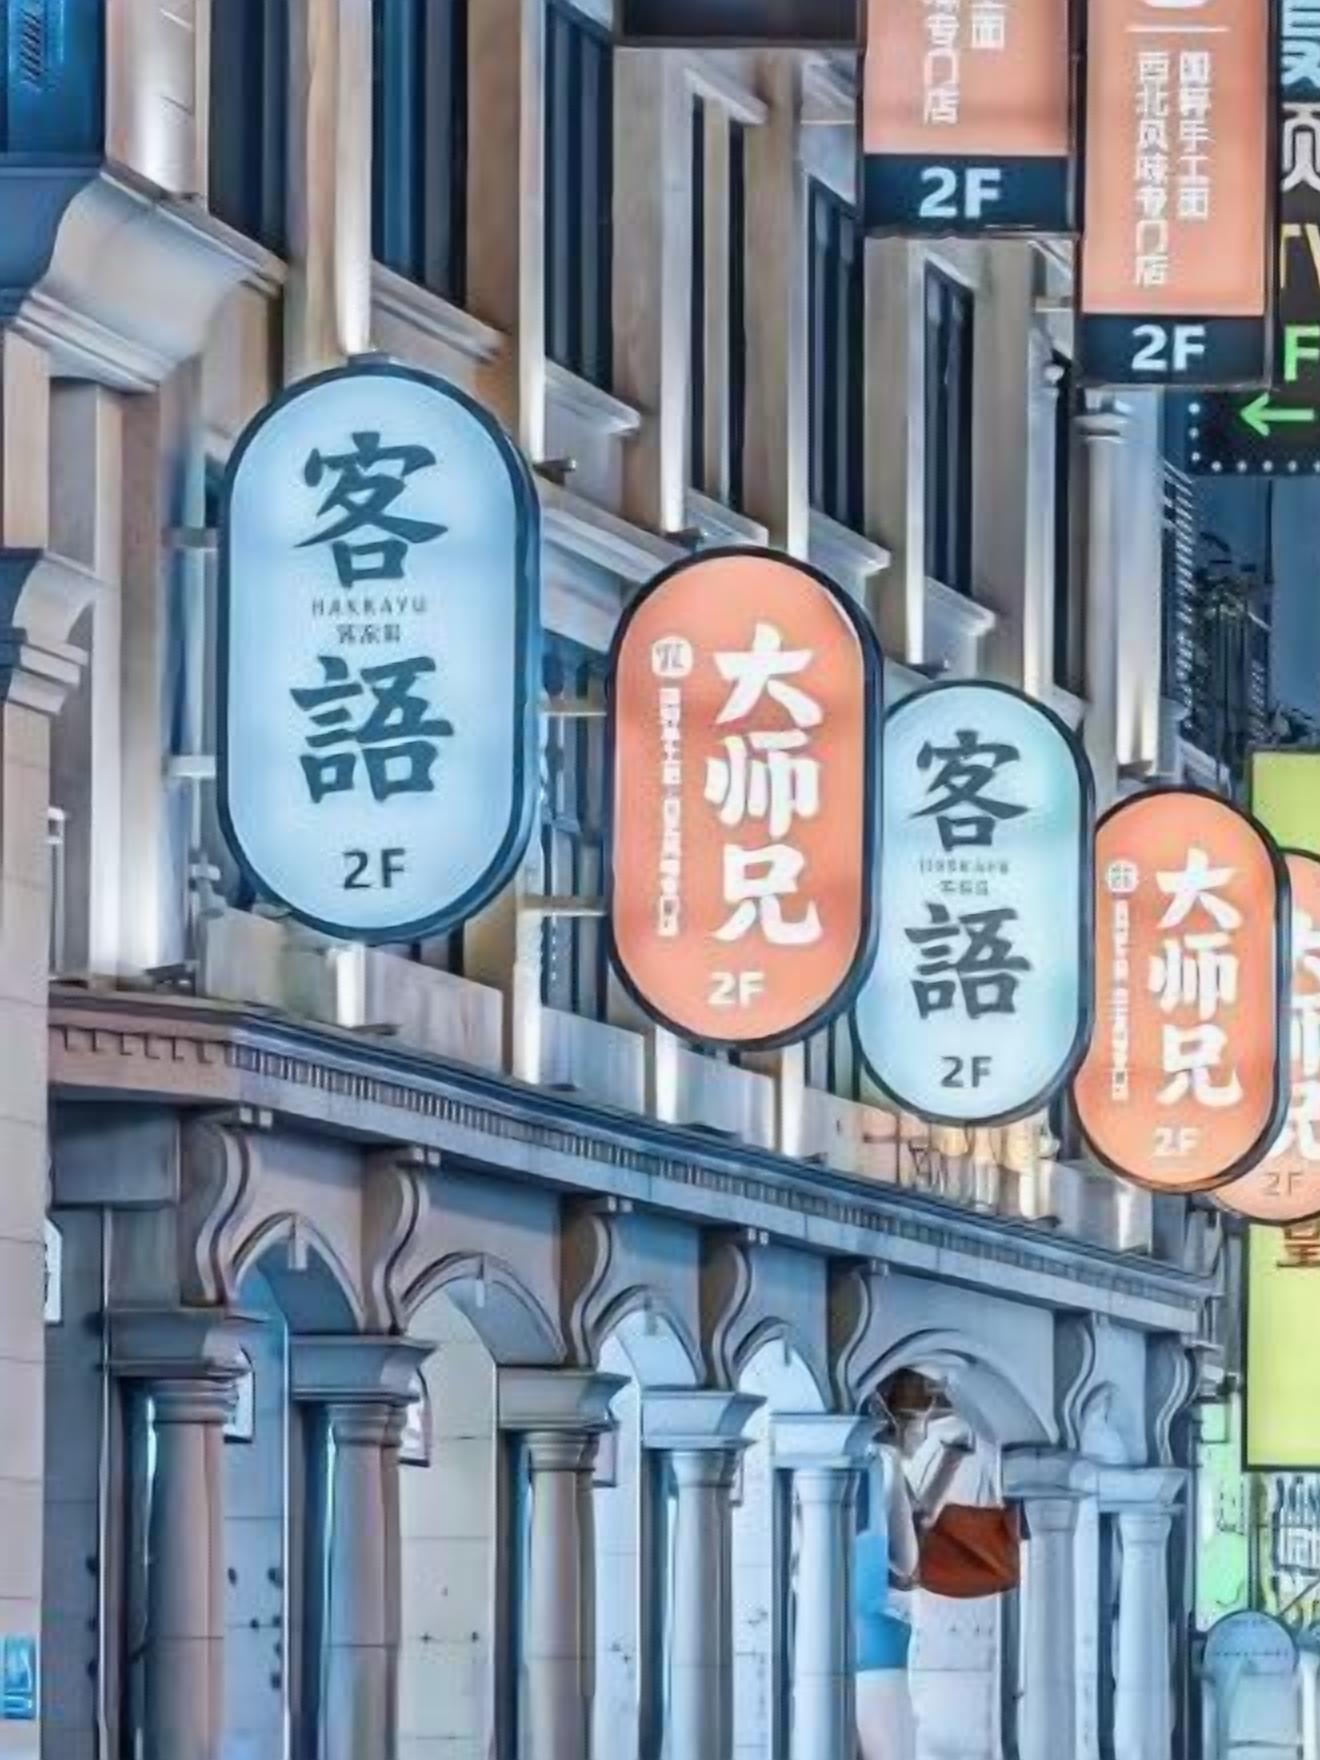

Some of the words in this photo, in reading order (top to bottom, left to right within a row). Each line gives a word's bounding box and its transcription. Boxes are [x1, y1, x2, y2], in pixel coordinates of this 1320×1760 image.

[922, 0, 959, 125] 专门店
[918, 165, 1002, 219] 2F
[1130, 325, 1206, 372] 2F
[289, 430, 456, 804] 客語
[703, 622, 824, 946] 大师兄
[341, 847, 408, 891] 2F
[905, 730, 1035, 1020] 客語
[708, 969, 766, 1007] 2F
[1147, 847, 1244, 1107] 大师兄
[939, 1055, 994, 1089] 2F
[1153, 1126, 1201, 1158] 2F
[1262, 1170, 1306, 1197] 2F
